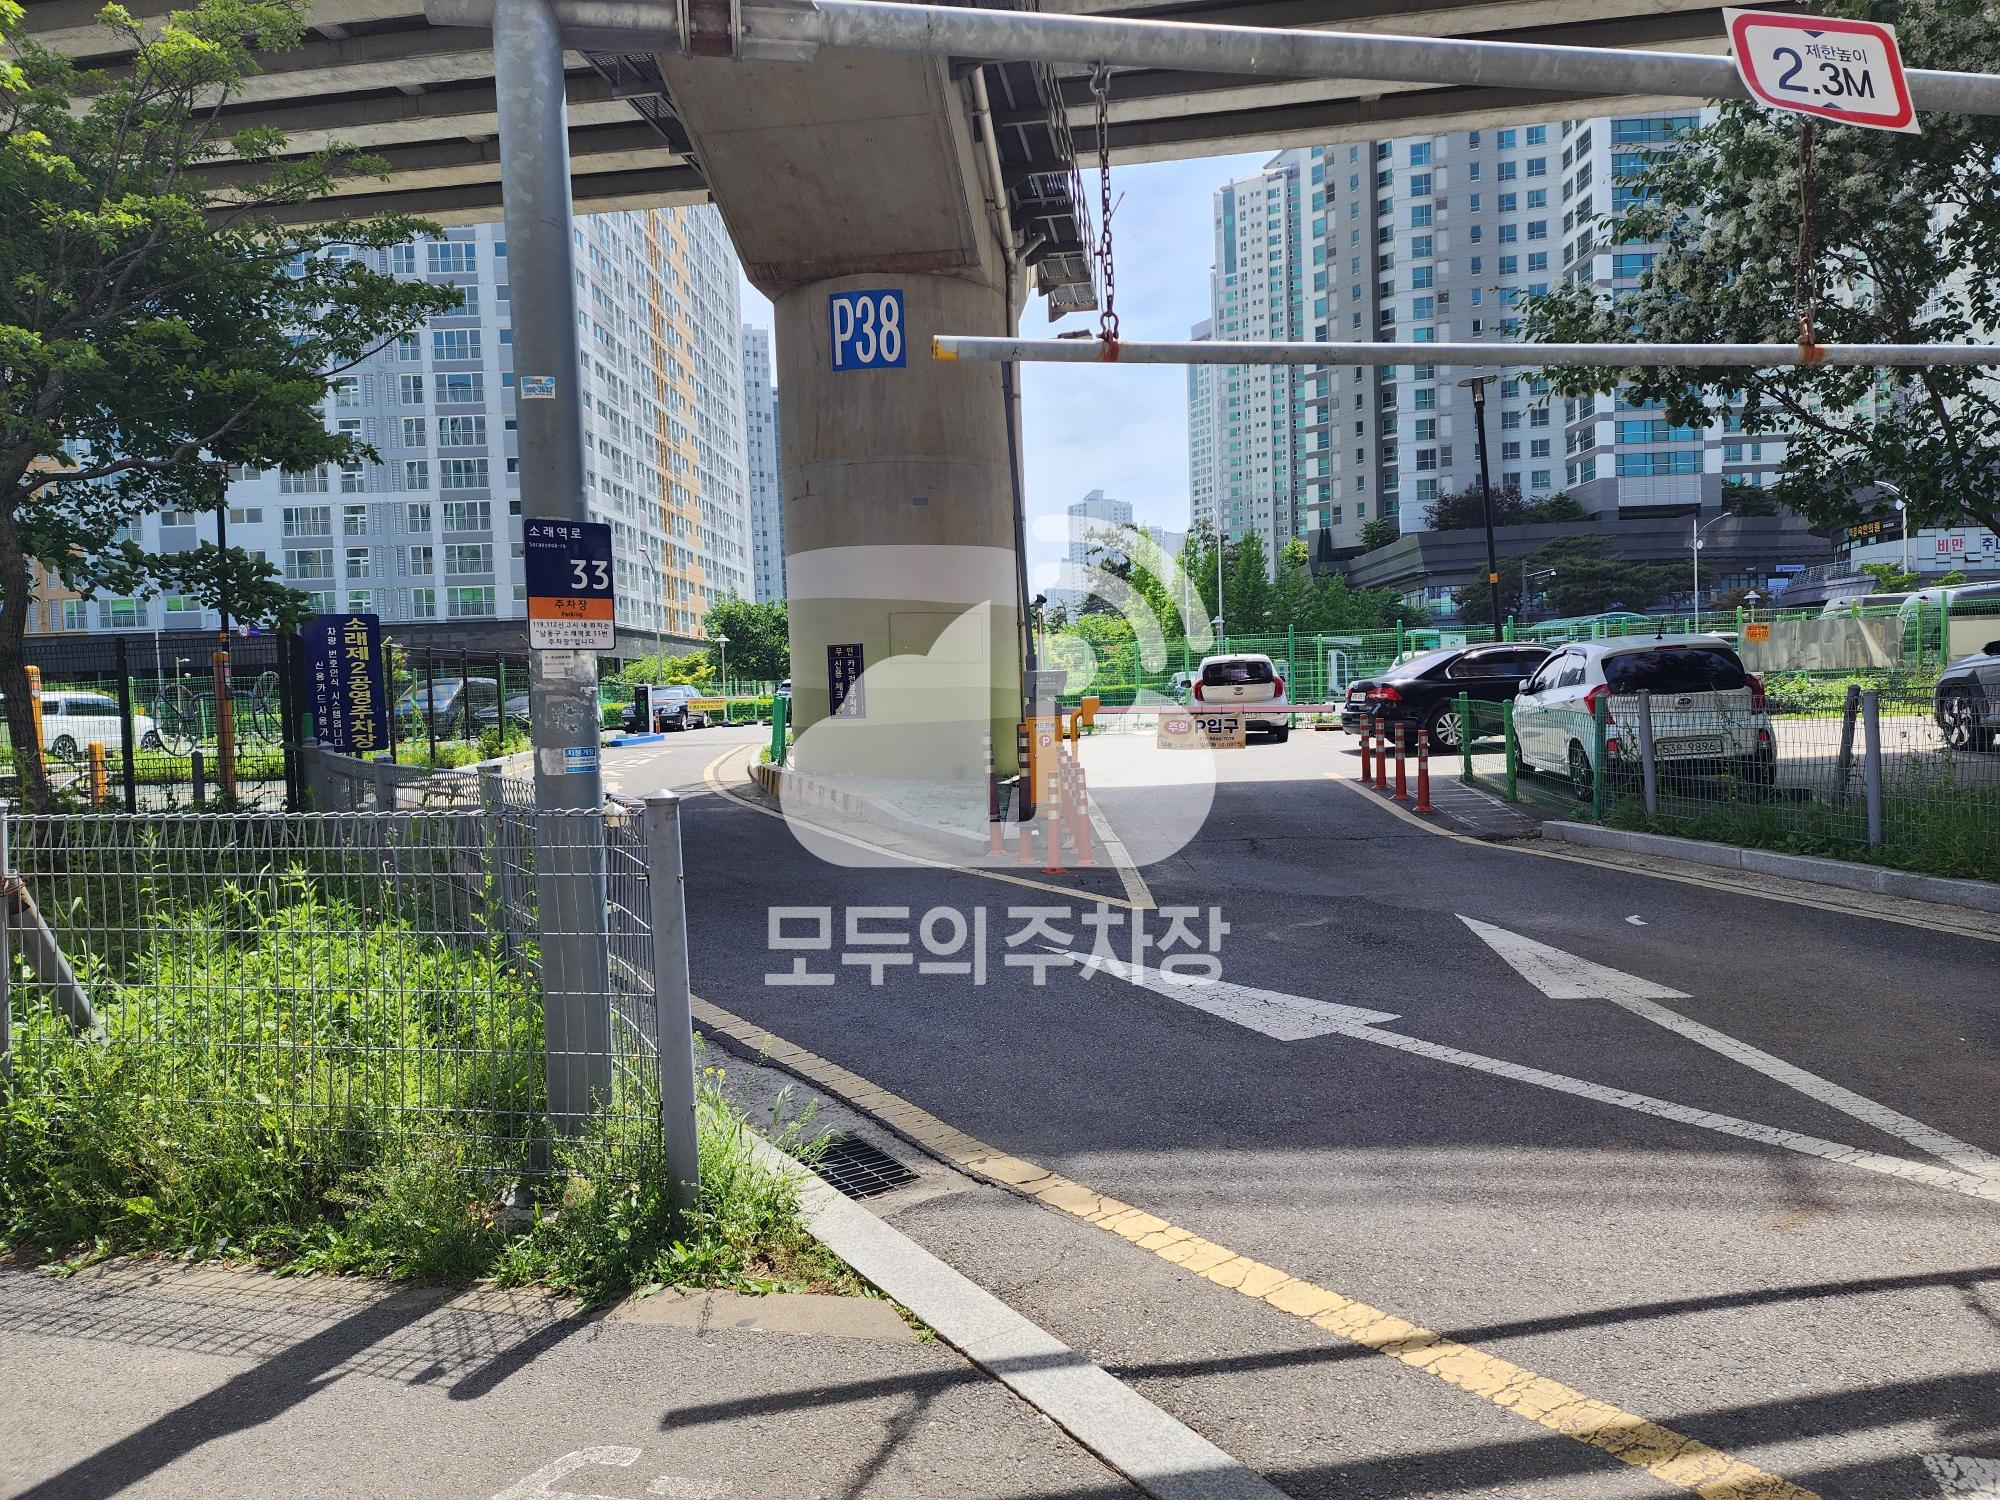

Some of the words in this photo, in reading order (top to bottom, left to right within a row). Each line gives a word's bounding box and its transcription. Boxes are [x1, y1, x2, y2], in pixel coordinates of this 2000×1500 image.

[1805, 43, 1867, 64] 제한높이
[1772, 47, 1875, 98] 2.3M
[833, 295, 901, 365] P38
[528, 525, 582, 540] 소래역로
[1937, 538, 1964, 552] 비만
[570, 560, 609, 590] 33
[555, 599, 588, 610] 주차장
[326, 627, 337, 646] 차량
[328, 649, 340, 687] 번호인식
[343, 617, 377, 748] 소래제2공영주차장
[315, 660, 329, 744] 신용카드사용가
[1168, 721, 1189, 733] 주의
[1195, 718, 1239, 734] P입구
[1042, 736, 1050, 747] P
[1688, 742, 1715, 752] 9896
